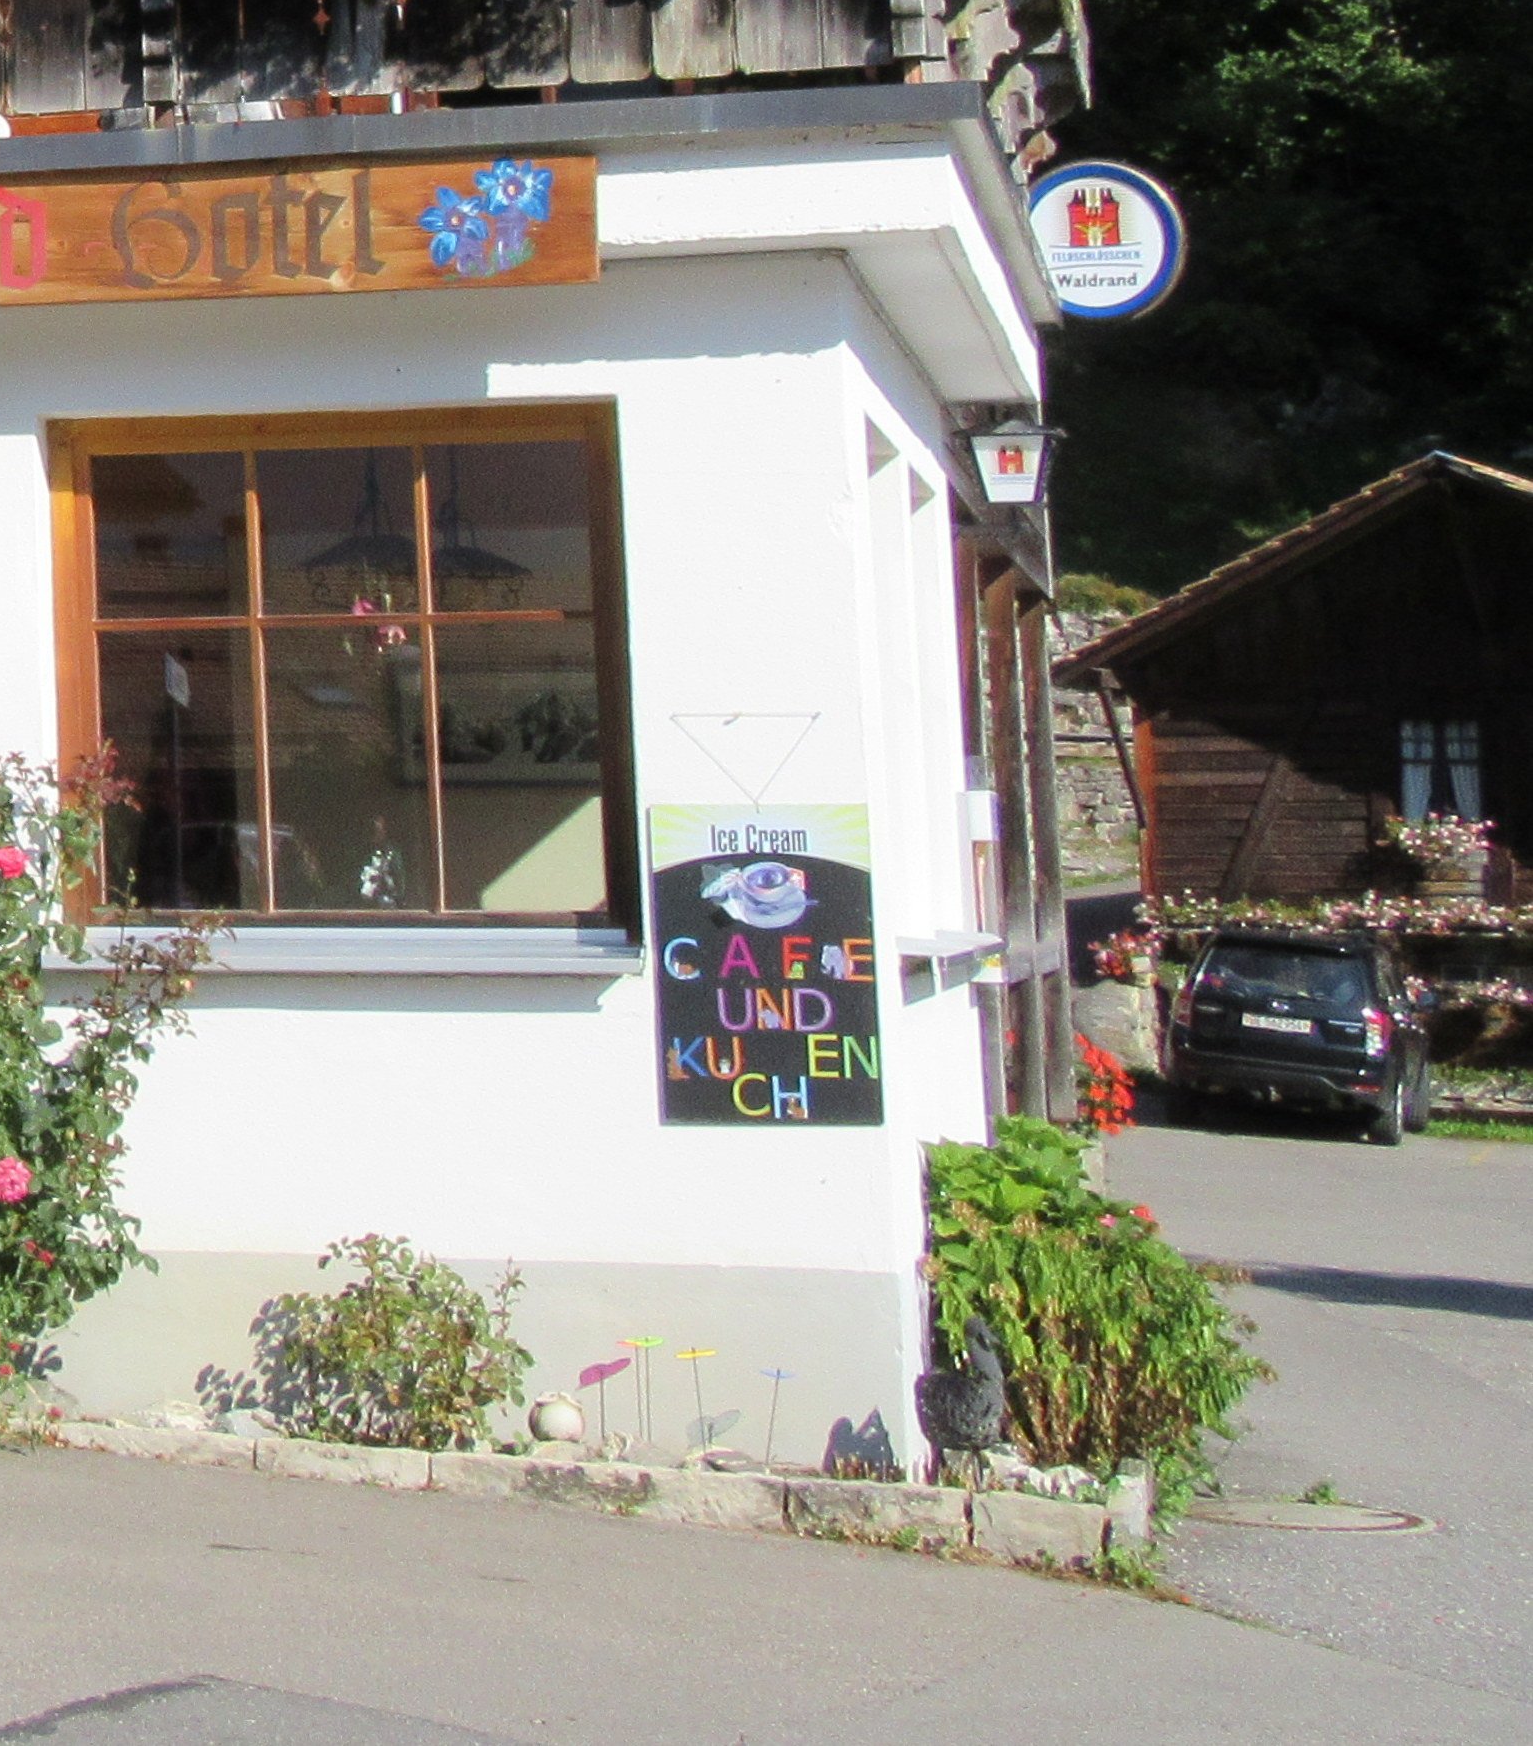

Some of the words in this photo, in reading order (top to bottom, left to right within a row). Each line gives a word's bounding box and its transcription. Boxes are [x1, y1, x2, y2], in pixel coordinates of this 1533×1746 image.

[1056, 273, 1138, 288] Waldrand
[710, 824, 739, 853] Ice
[744, 824, 809, 853] Cream
[716, 987, 833, 1033] UND
